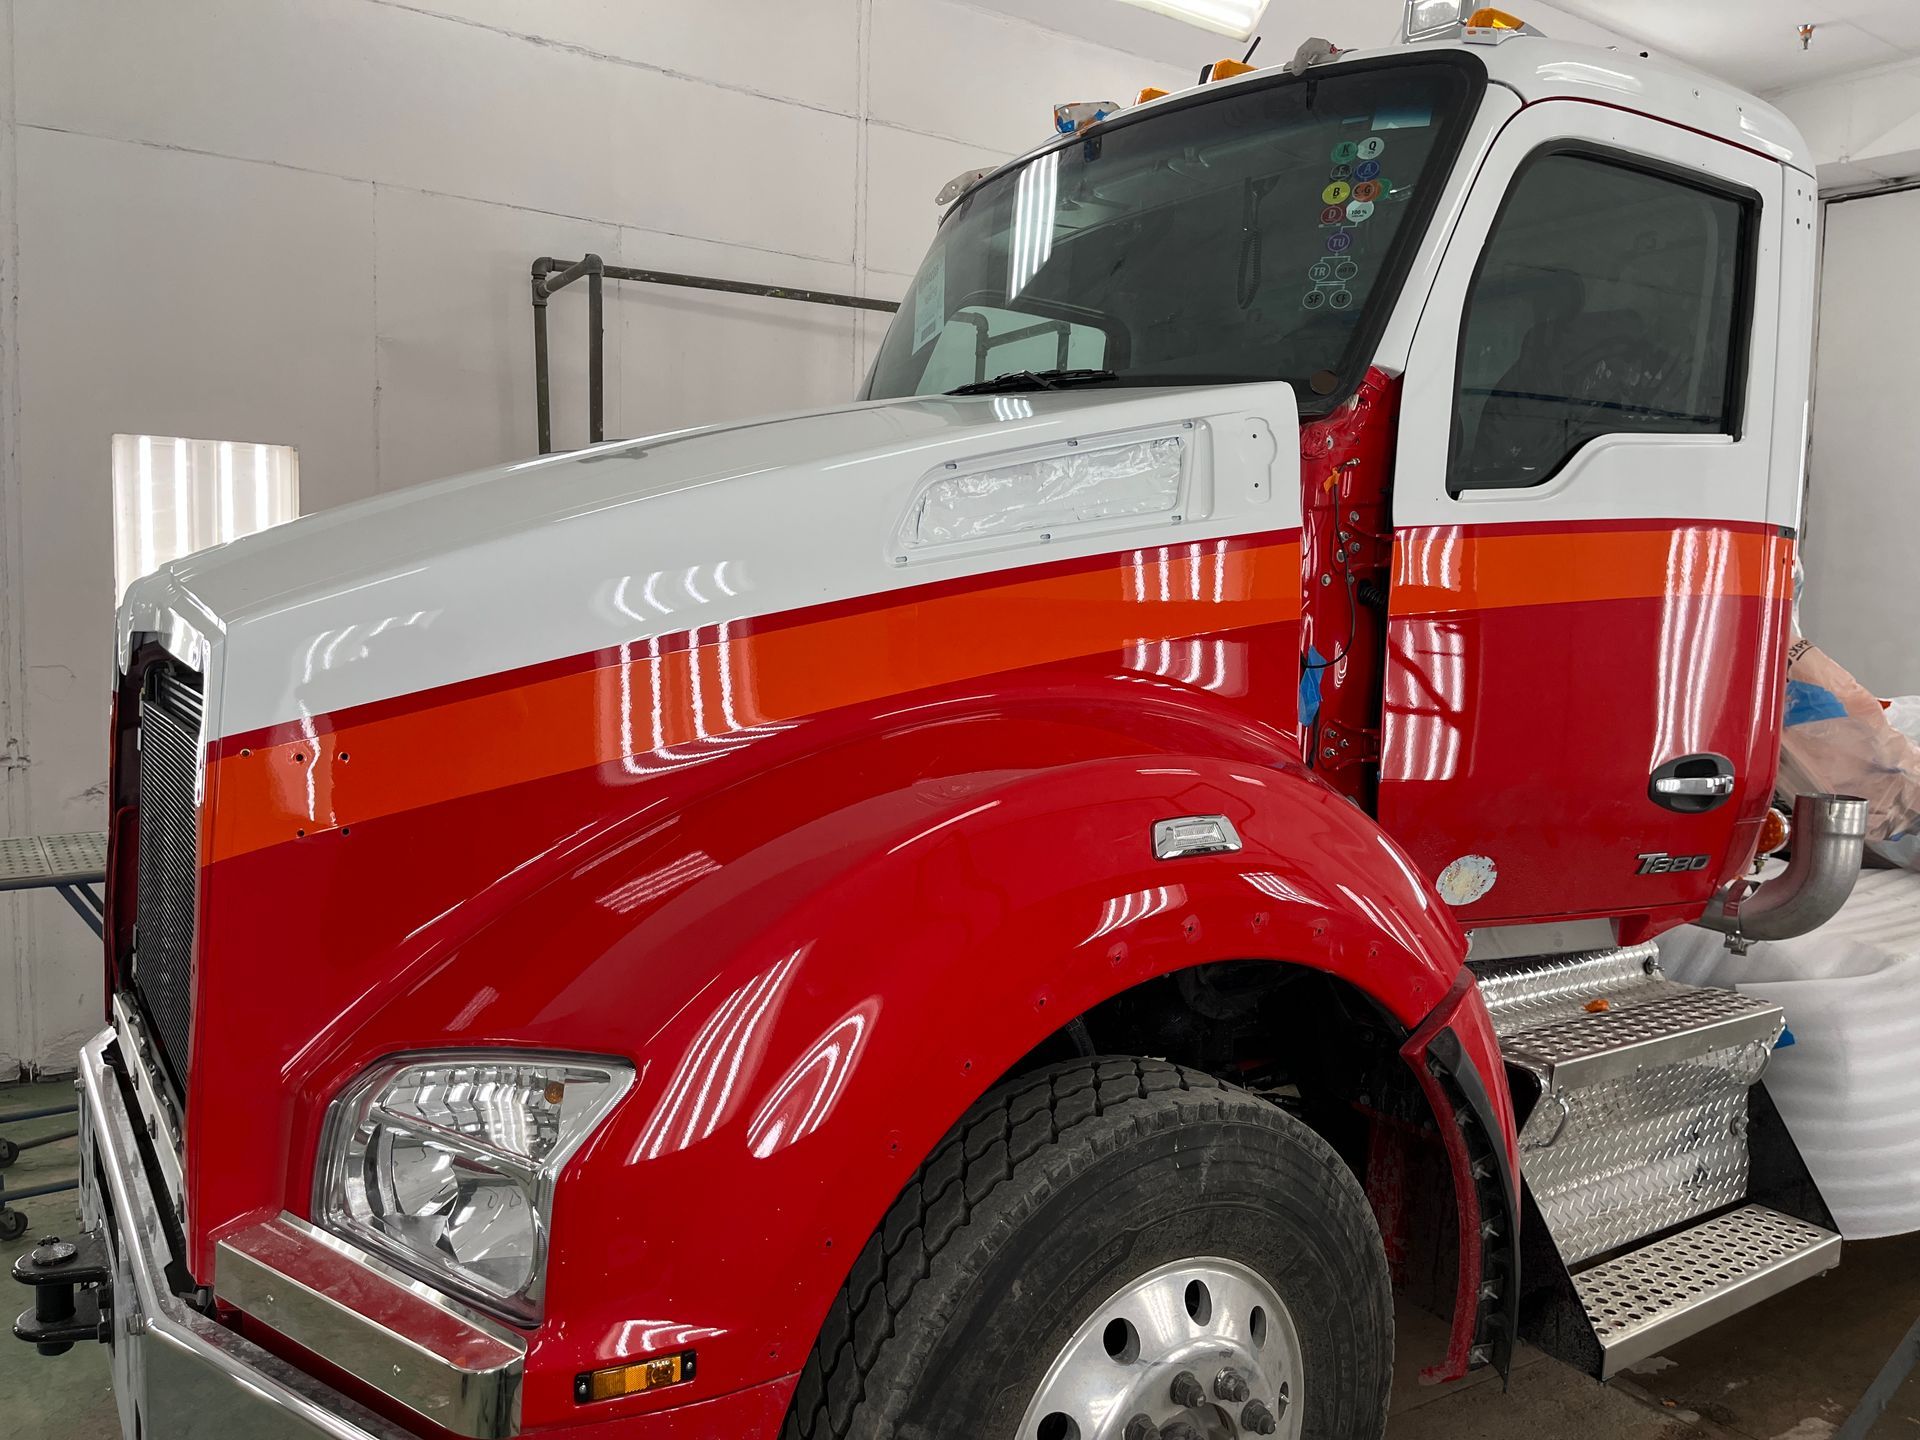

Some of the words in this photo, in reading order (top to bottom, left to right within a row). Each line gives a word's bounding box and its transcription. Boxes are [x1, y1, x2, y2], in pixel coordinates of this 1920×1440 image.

[1369, 140, 1377, 151] Q
[1333, 187, 1340, 197] B
[1328, 209, 1336, 219] D
[1332, 237, 1345, 247] TU
[1313, 266, 1326, 276] TR
[1308, 294, 1320, 304] SF
[1336, 294, 1347, 304] CF
[1635, 852, 1711, 875] T880
